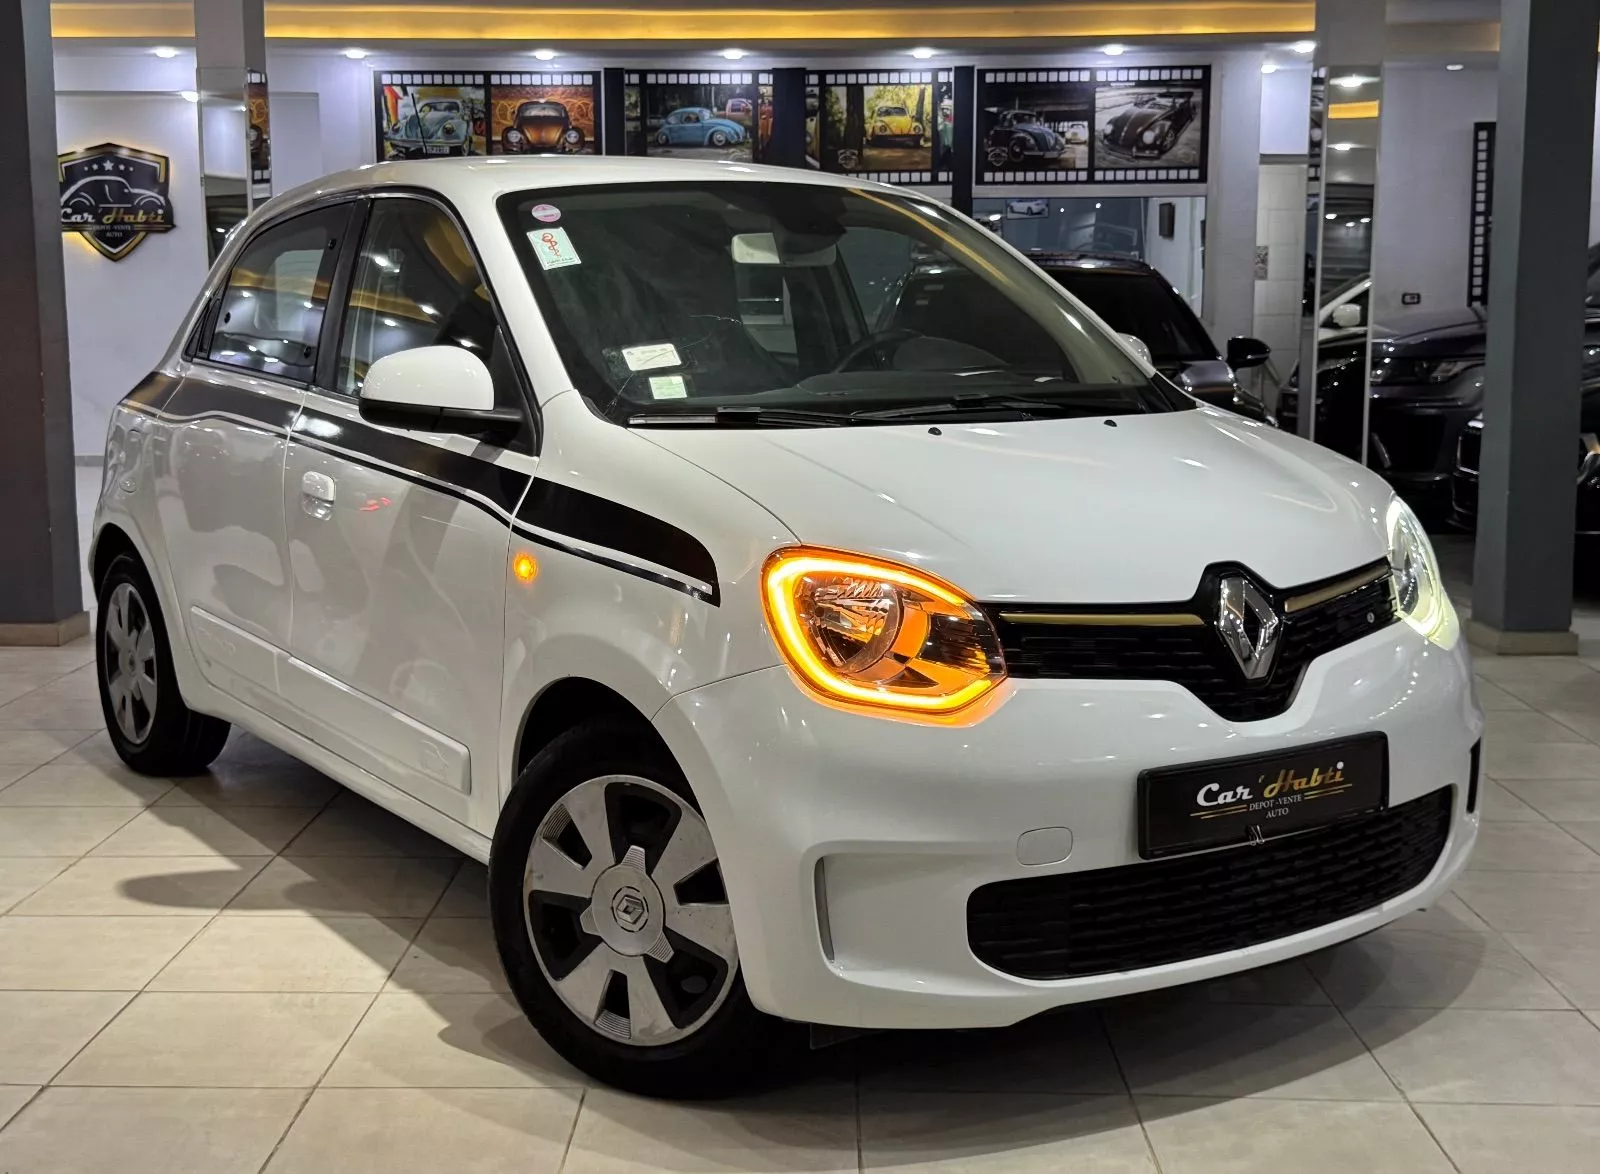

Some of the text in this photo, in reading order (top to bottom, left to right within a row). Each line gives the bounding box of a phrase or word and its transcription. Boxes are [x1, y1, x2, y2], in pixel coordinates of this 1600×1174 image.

[61, 207, 95, 223] Car
[1197, 783, 1253, 806] Car
[1266, 807, 1289, 819] AUTO
